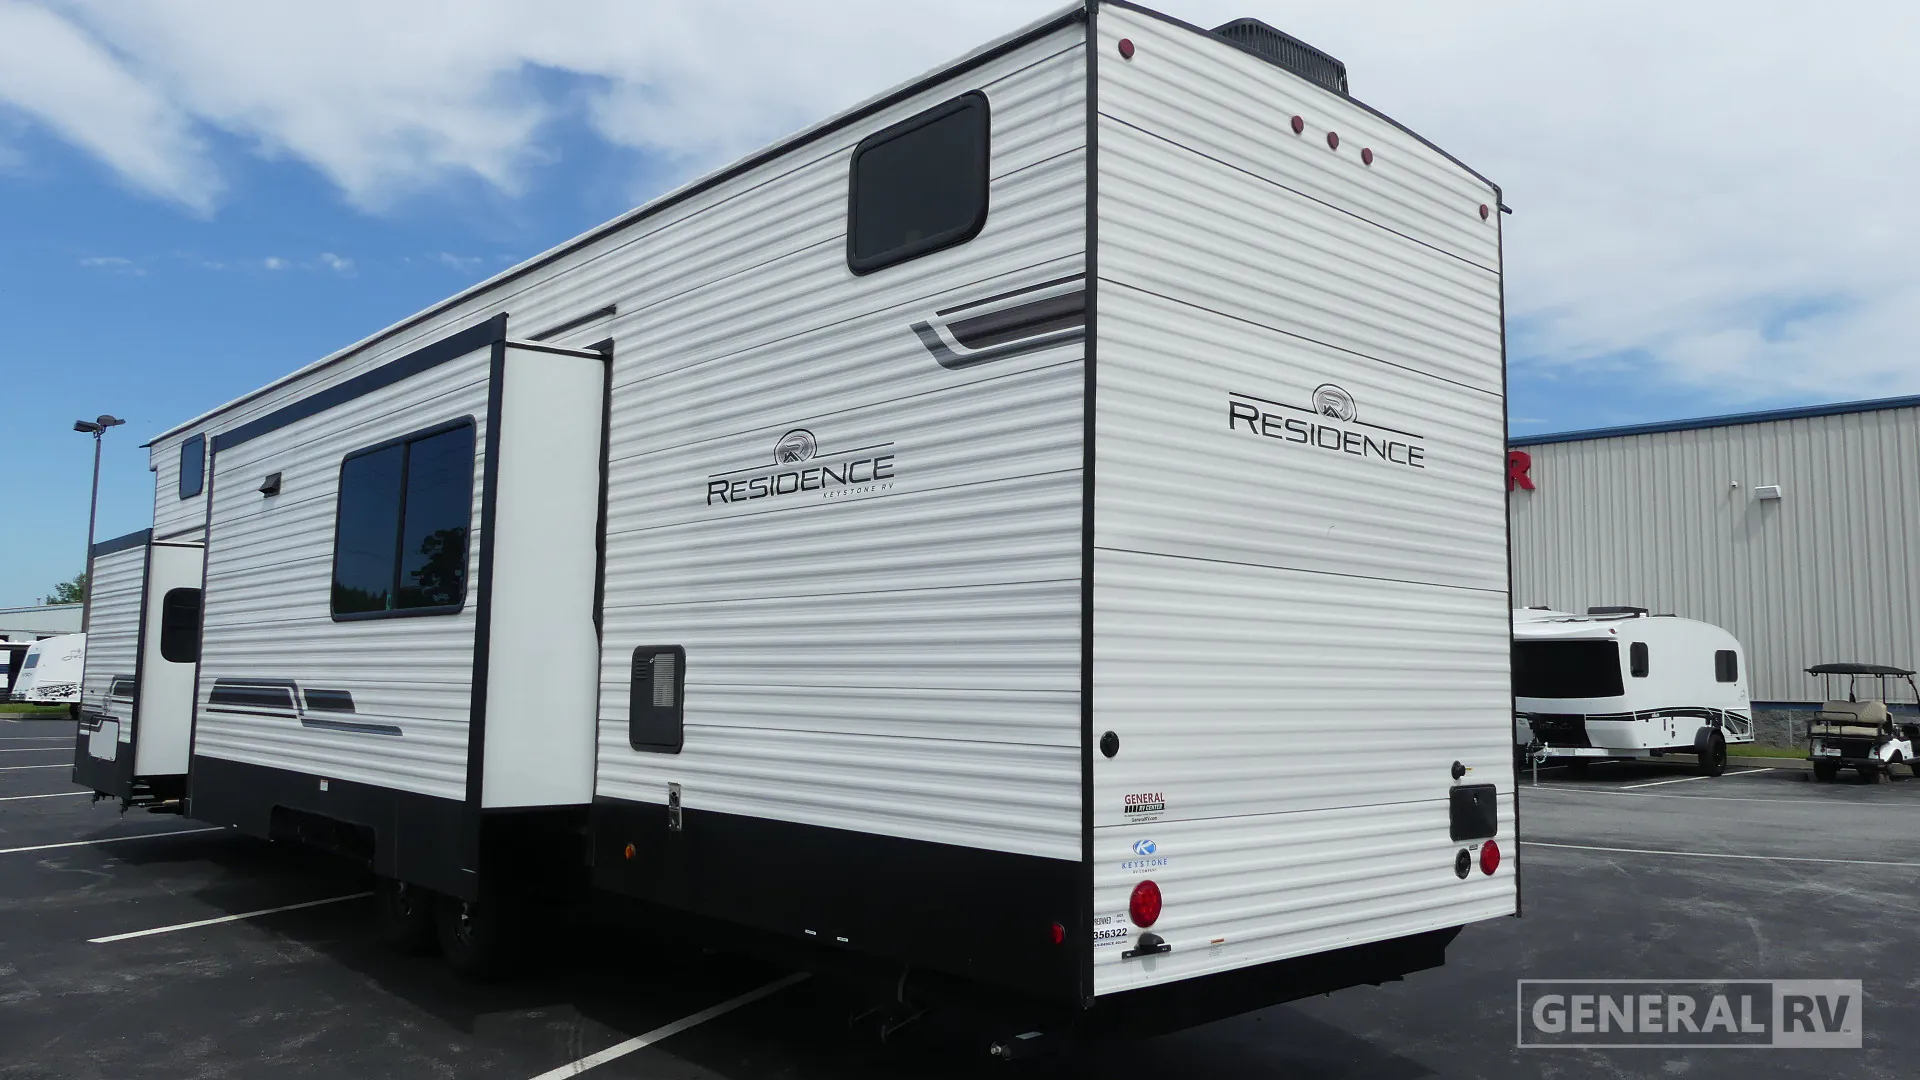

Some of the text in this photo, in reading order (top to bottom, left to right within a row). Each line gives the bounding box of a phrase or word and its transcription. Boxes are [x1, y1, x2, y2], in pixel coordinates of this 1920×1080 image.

[1229, 400, 1425, 469] RESIDENCE
[707, 454, 895, 506] RESIDENCE
[822, 482, 895, 499] KEYSTONE RV
[1124, 792, 1164, 804] GENERAL
[1121, 858, 1168, 869] KEYSTONE
[1093, 928, 1127, 939] 356322
